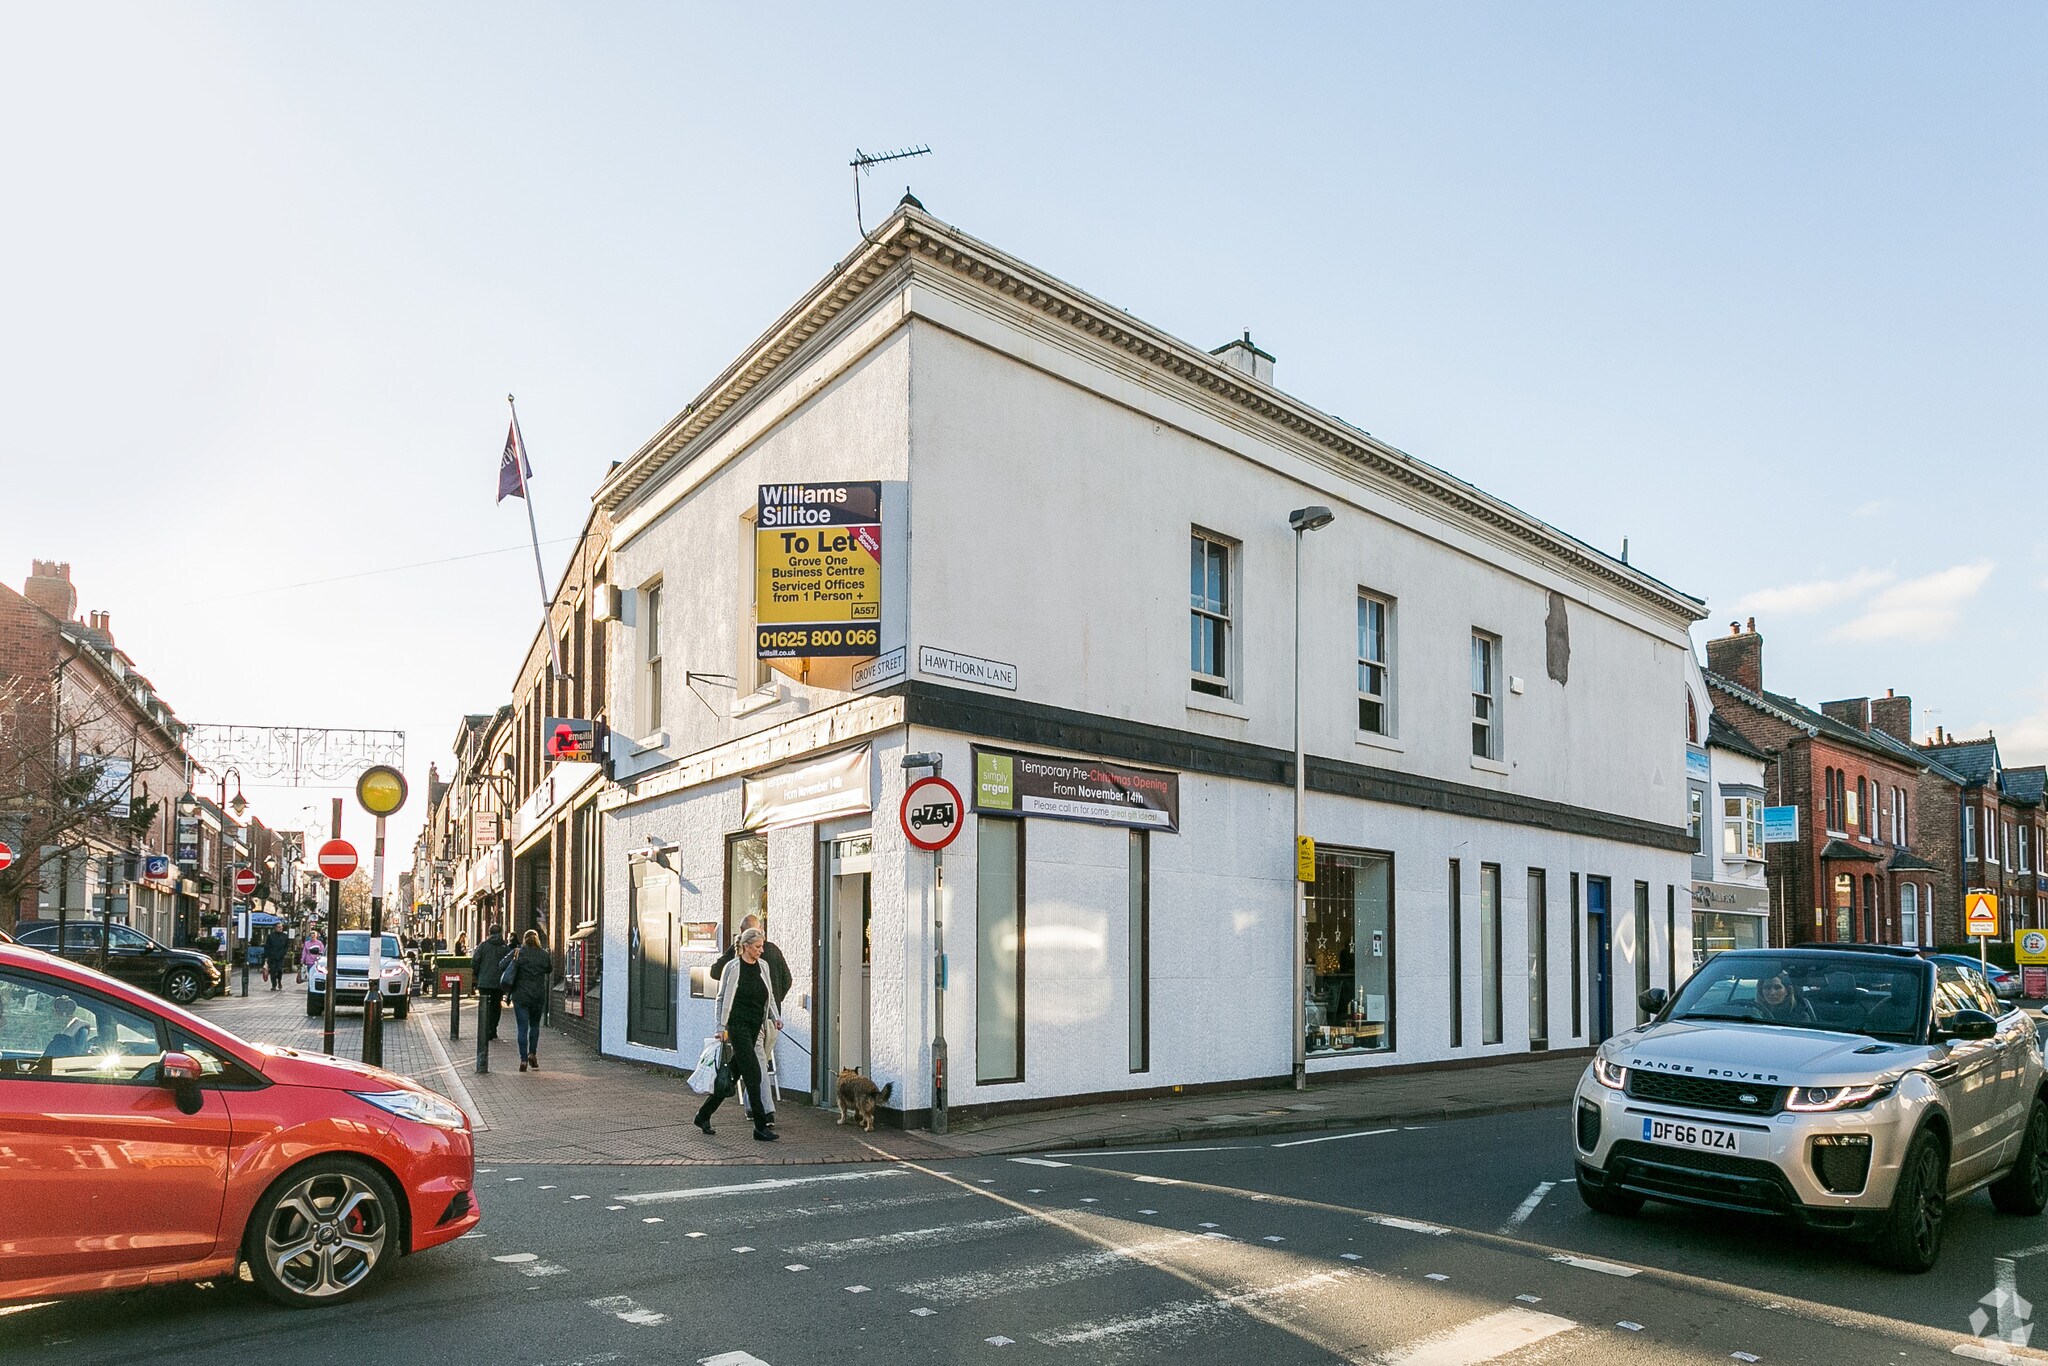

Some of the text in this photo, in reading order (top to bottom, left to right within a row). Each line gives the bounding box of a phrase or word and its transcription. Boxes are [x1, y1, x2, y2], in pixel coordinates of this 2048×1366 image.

[762, 486, 848, 505] Williams
[762, 506, 831, 526] Sillitoe
[780, 532, 857, 554] To Let
[858, 534, 872, 551] Soon
[860, 527, 879, 550] Coming
[788, 556, 848, 566] Grove One
[772, 566, 864, 578] Business Centre
[772, 579, 864, 592] Serviced Offices
[773, 592, 799, 602] from
[804, 592, 808, 601] 1
[814, 591, 852, 600] Person
[854, 606, 876, 614] A557
[759, 629, 876, 648] 01625 800 066
[855, 655, 902, 682] GROVE STREET
[925, 654, 1012, 683] HAWTHORN LANE
[983, 770, 1008, 784] simply
[1020, 760, 1168, 793] Temporary Pre-Christmas Opening
[798, 782, 830, 798] November
[982, 783, 1010, 795] argan
[1054, 782, 1144, 804] From November 14th
[1034, 800, 1057, 810] Please
[1058, 804, 1071, 812] call
[1073, 805, 1078, 813] in
[1080, 804, 1090, 813] for
[1091, 807, 1109, 816] some
[1111, 810, 1127, 819] great
[1632, 1058, 1778, 1082] RANGE ROVER
[1654, 1122, 1736, 1150] DF66 OZA
